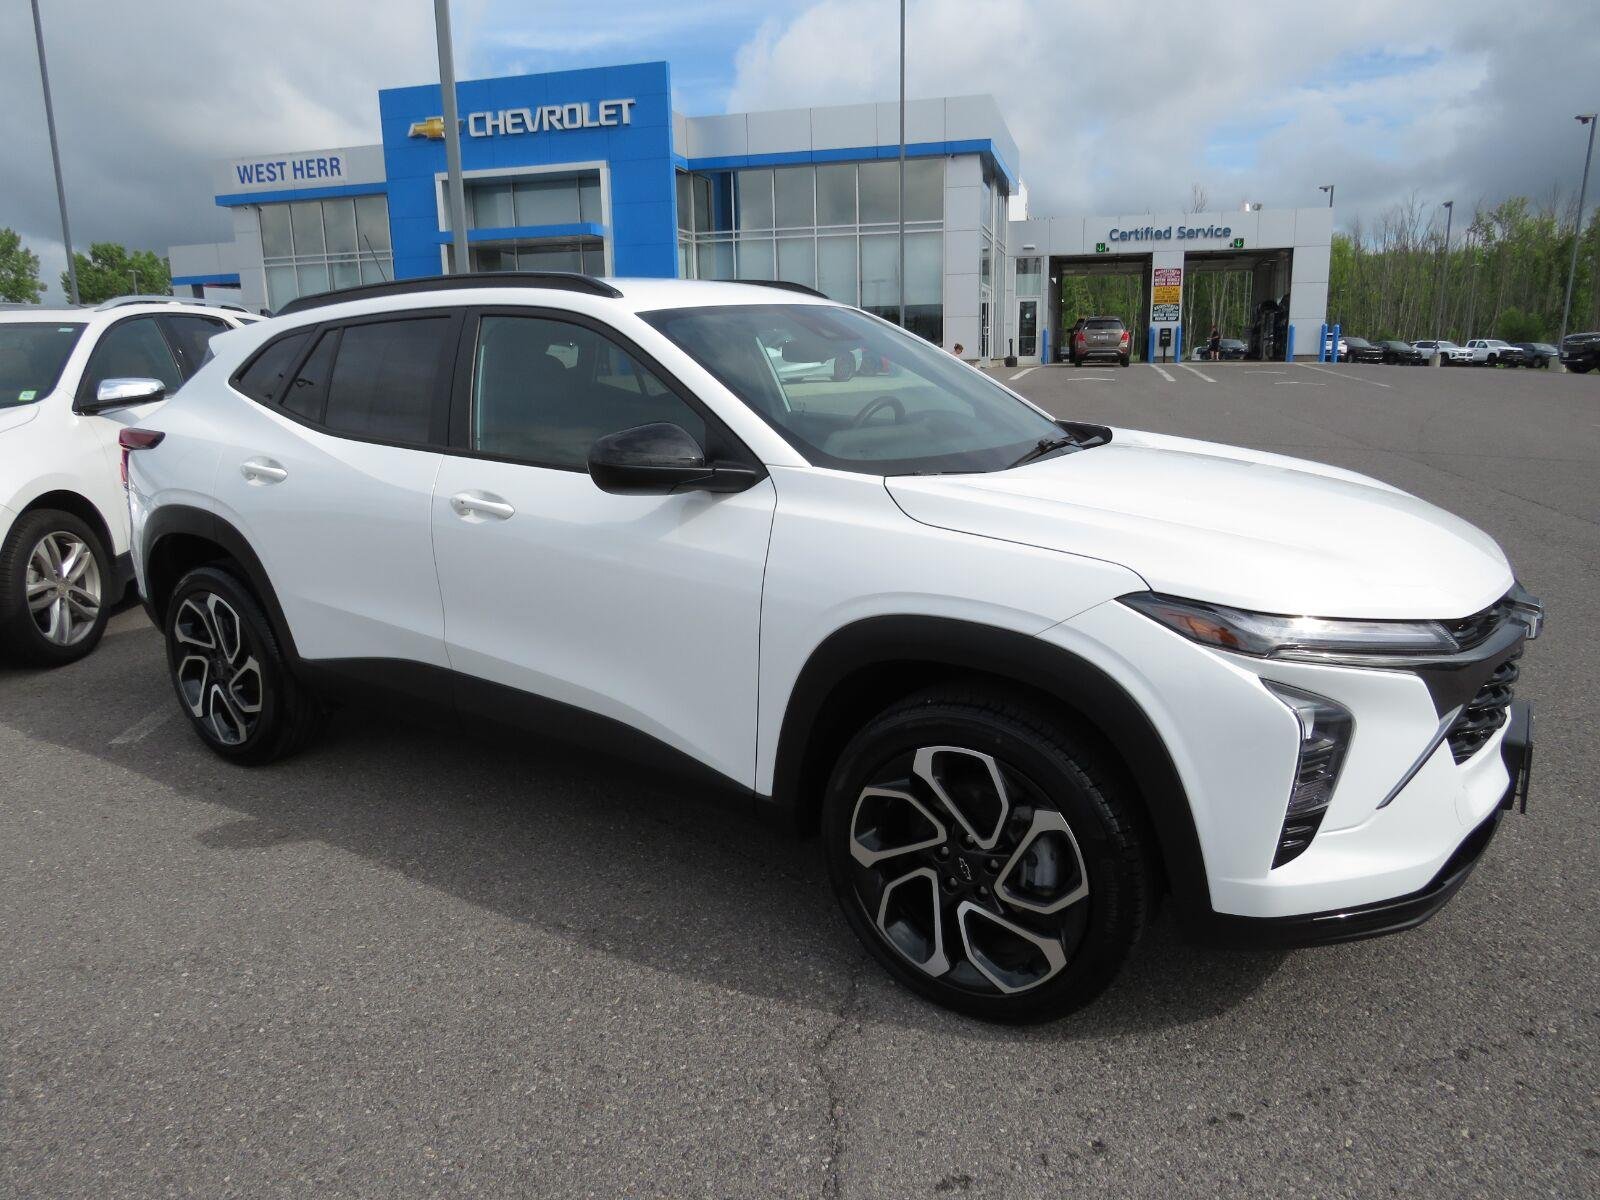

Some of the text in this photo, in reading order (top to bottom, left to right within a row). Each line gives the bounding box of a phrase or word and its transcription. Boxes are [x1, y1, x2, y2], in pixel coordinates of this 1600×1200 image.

[468, 98, 636, 138] CHEVROLET
[236, 157, 342, 185] WEST HERR
[1109, 225, 1231, 241] Certified Service
